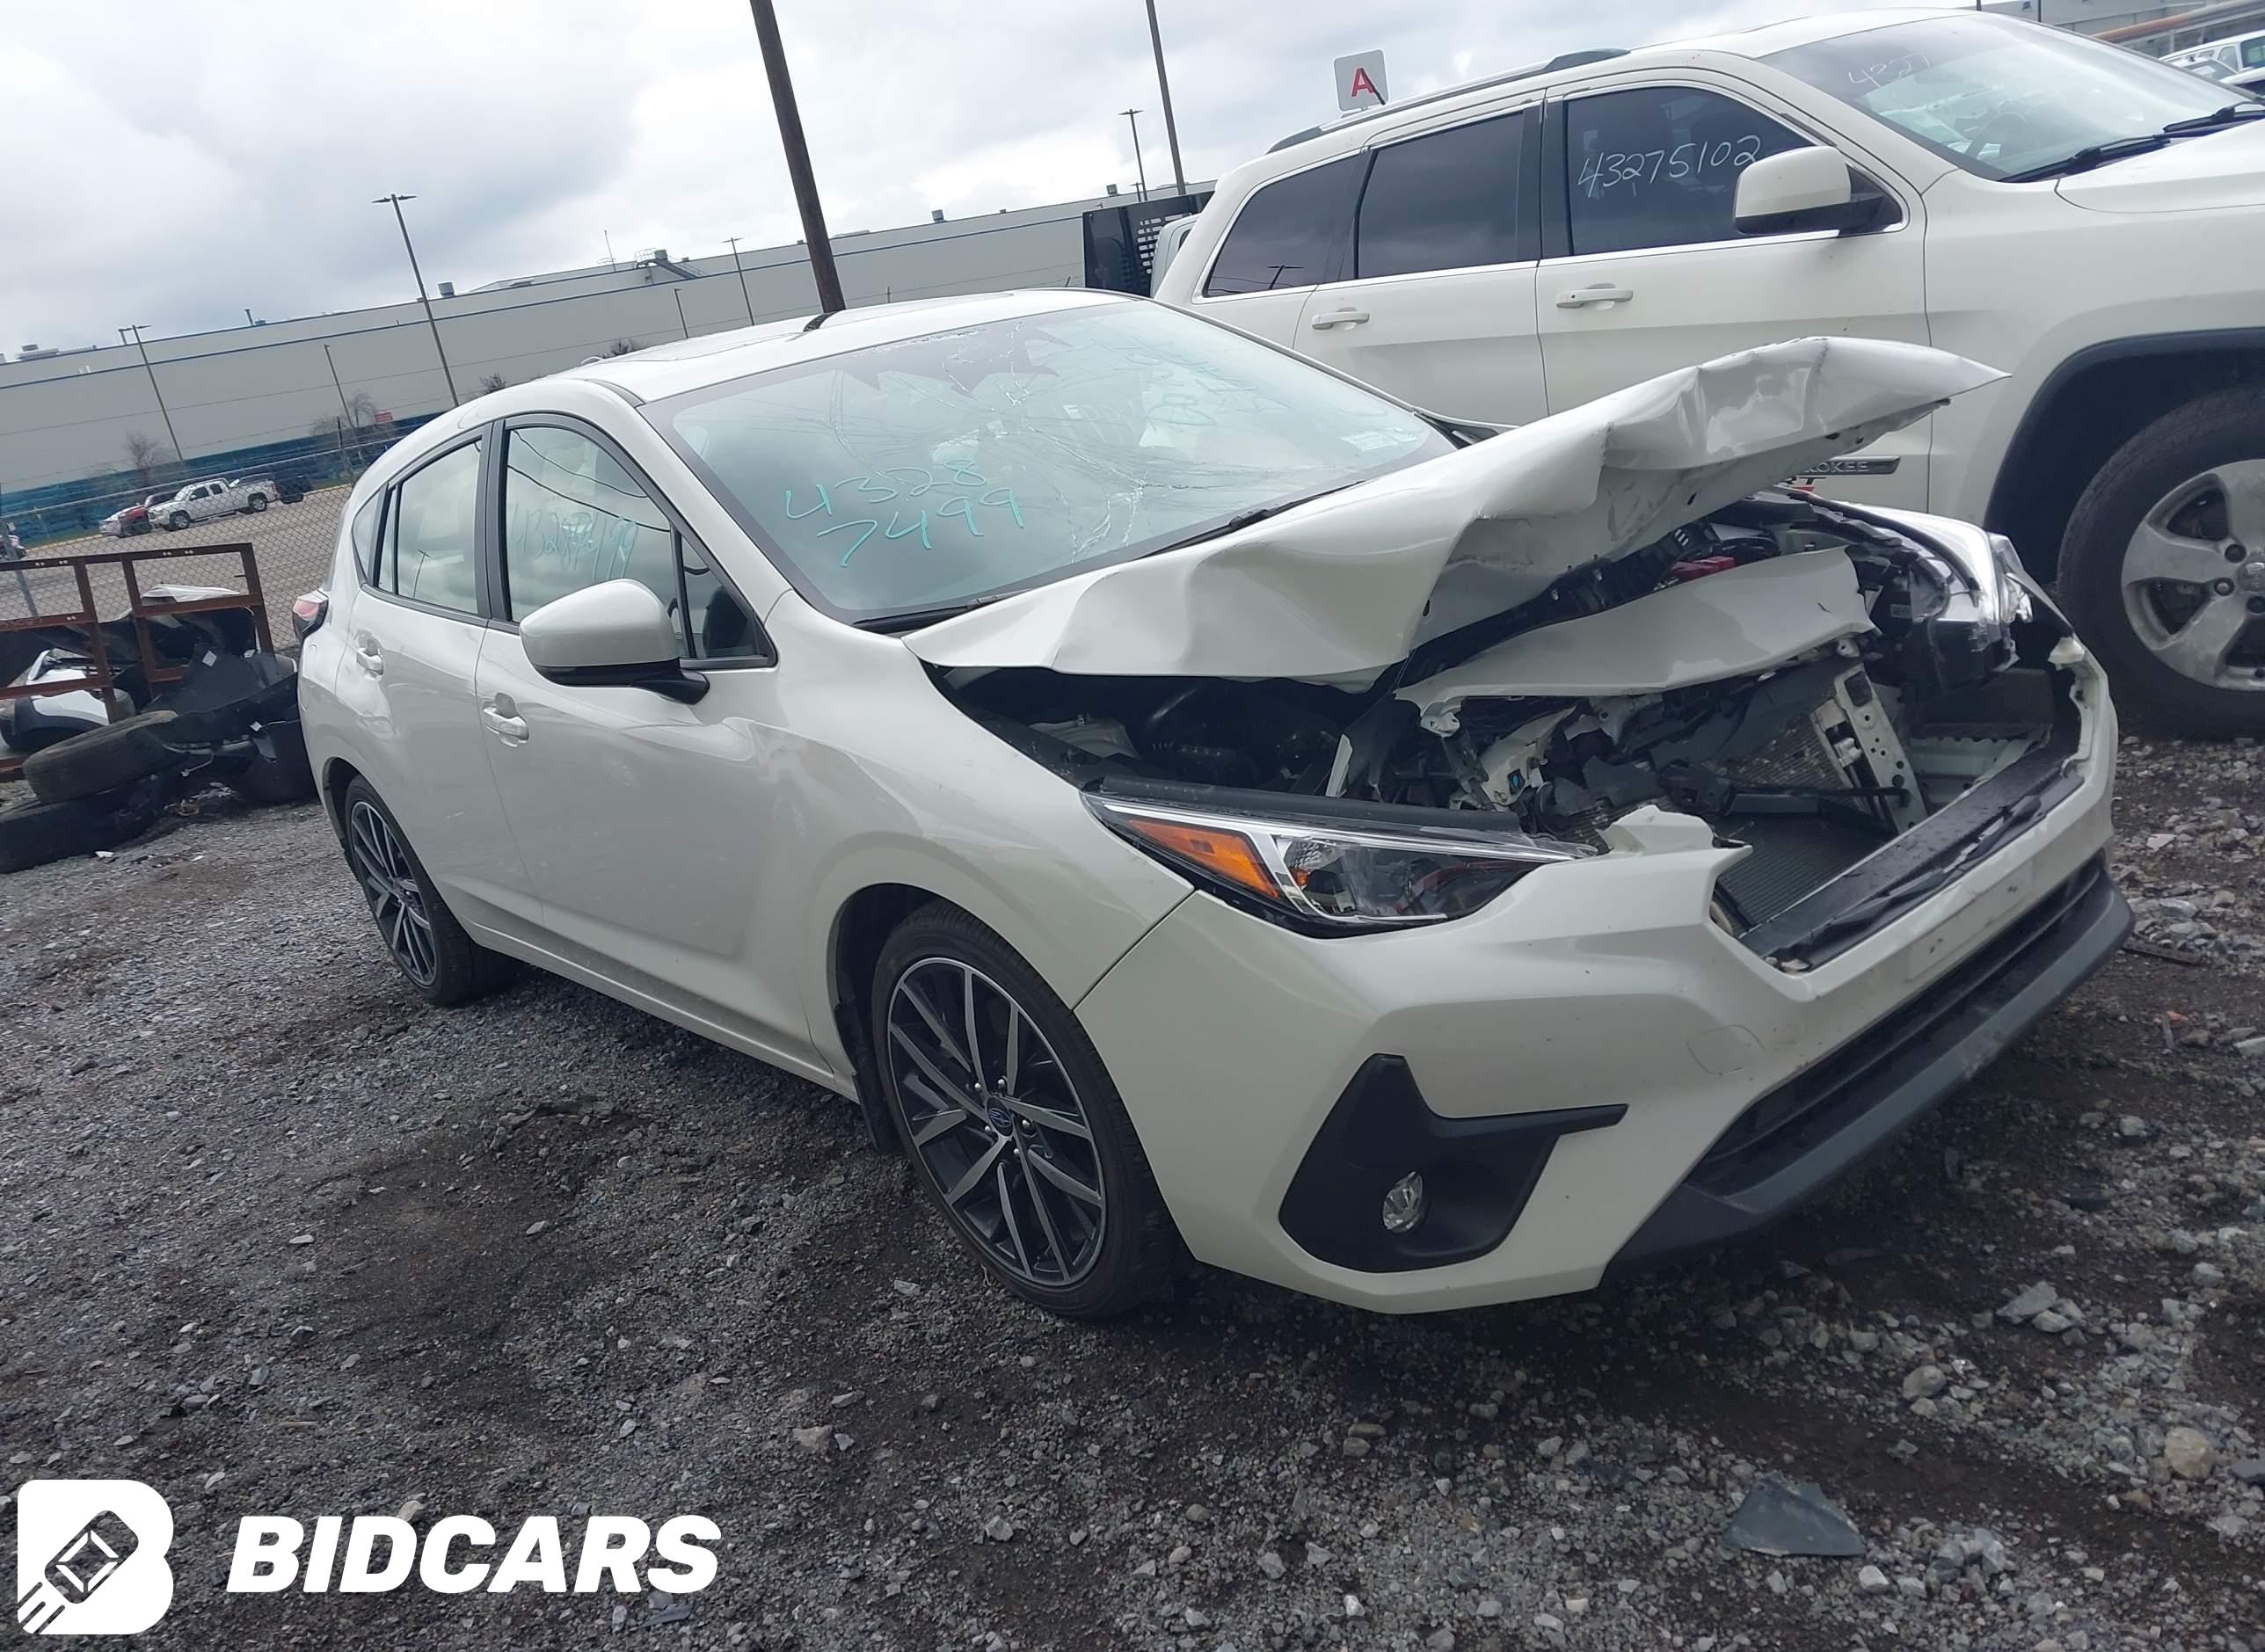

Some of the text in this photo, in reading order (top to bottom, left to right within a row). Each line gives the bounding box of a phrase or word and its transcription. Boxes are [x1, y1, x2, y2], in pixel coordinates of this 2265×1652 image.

[1351, 68, 1375, 97] A
[1577, 135, 1761, 198] 43275102
[785, 459, 987, 520] 4328
[816, 487, 1025, 567] 7499
